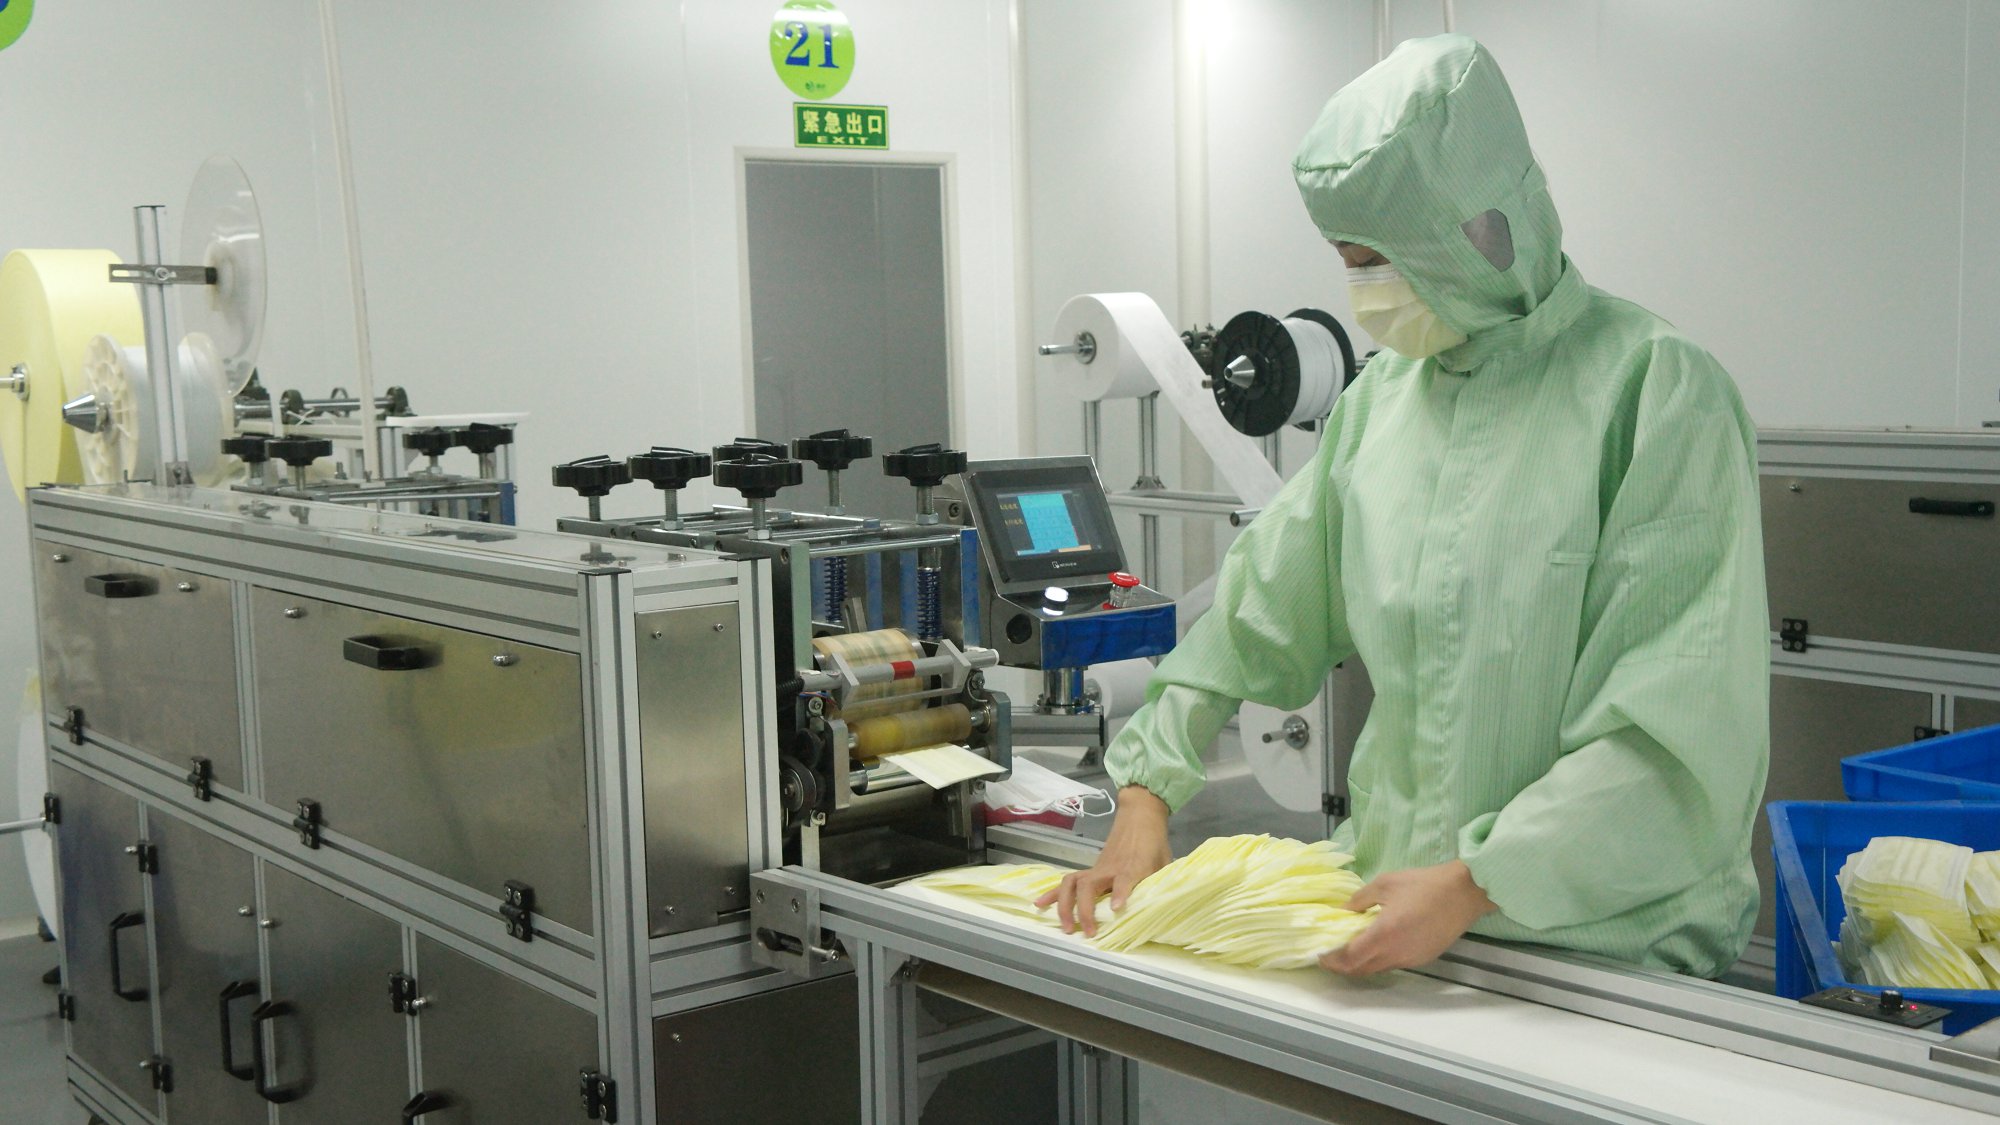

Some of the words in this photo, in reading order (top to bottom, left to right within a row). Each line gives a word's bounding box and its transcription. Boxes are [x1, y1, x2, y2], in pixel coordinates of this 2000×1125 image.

[784, 21, 839, 68] 21
[802, 110, 882, 134] 紧急出口
[816, 135, 868, 144] EXIT
